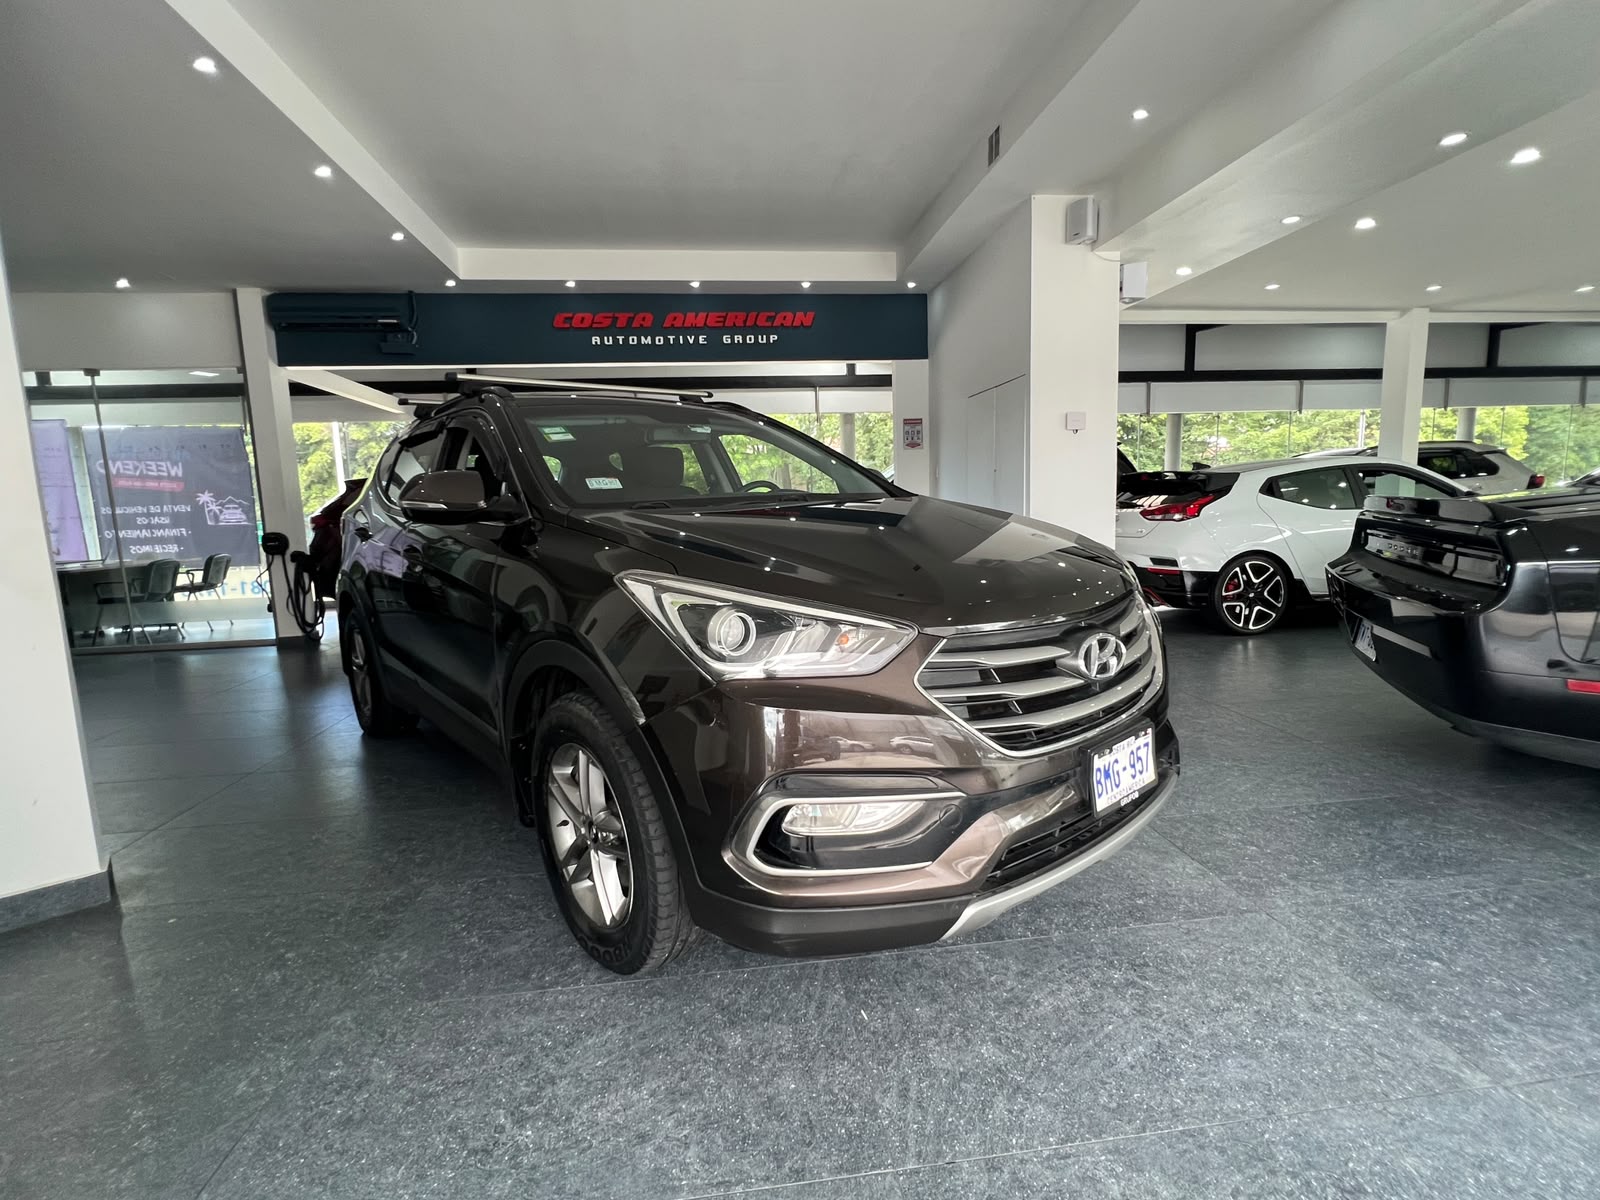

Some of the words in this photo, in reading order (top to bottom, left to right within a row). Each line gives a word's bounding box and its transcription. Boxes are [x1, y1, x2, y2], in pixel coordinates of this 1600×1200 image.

[552, 312, 654, 329] COSTA
[661, 311, 816, 328] AMERICAN
[591, 335, 708, 345] AUTOMOTIVE
[722, 334, 779, 344] GROUP
[1095, 741, 1150, 799] BMG-957
